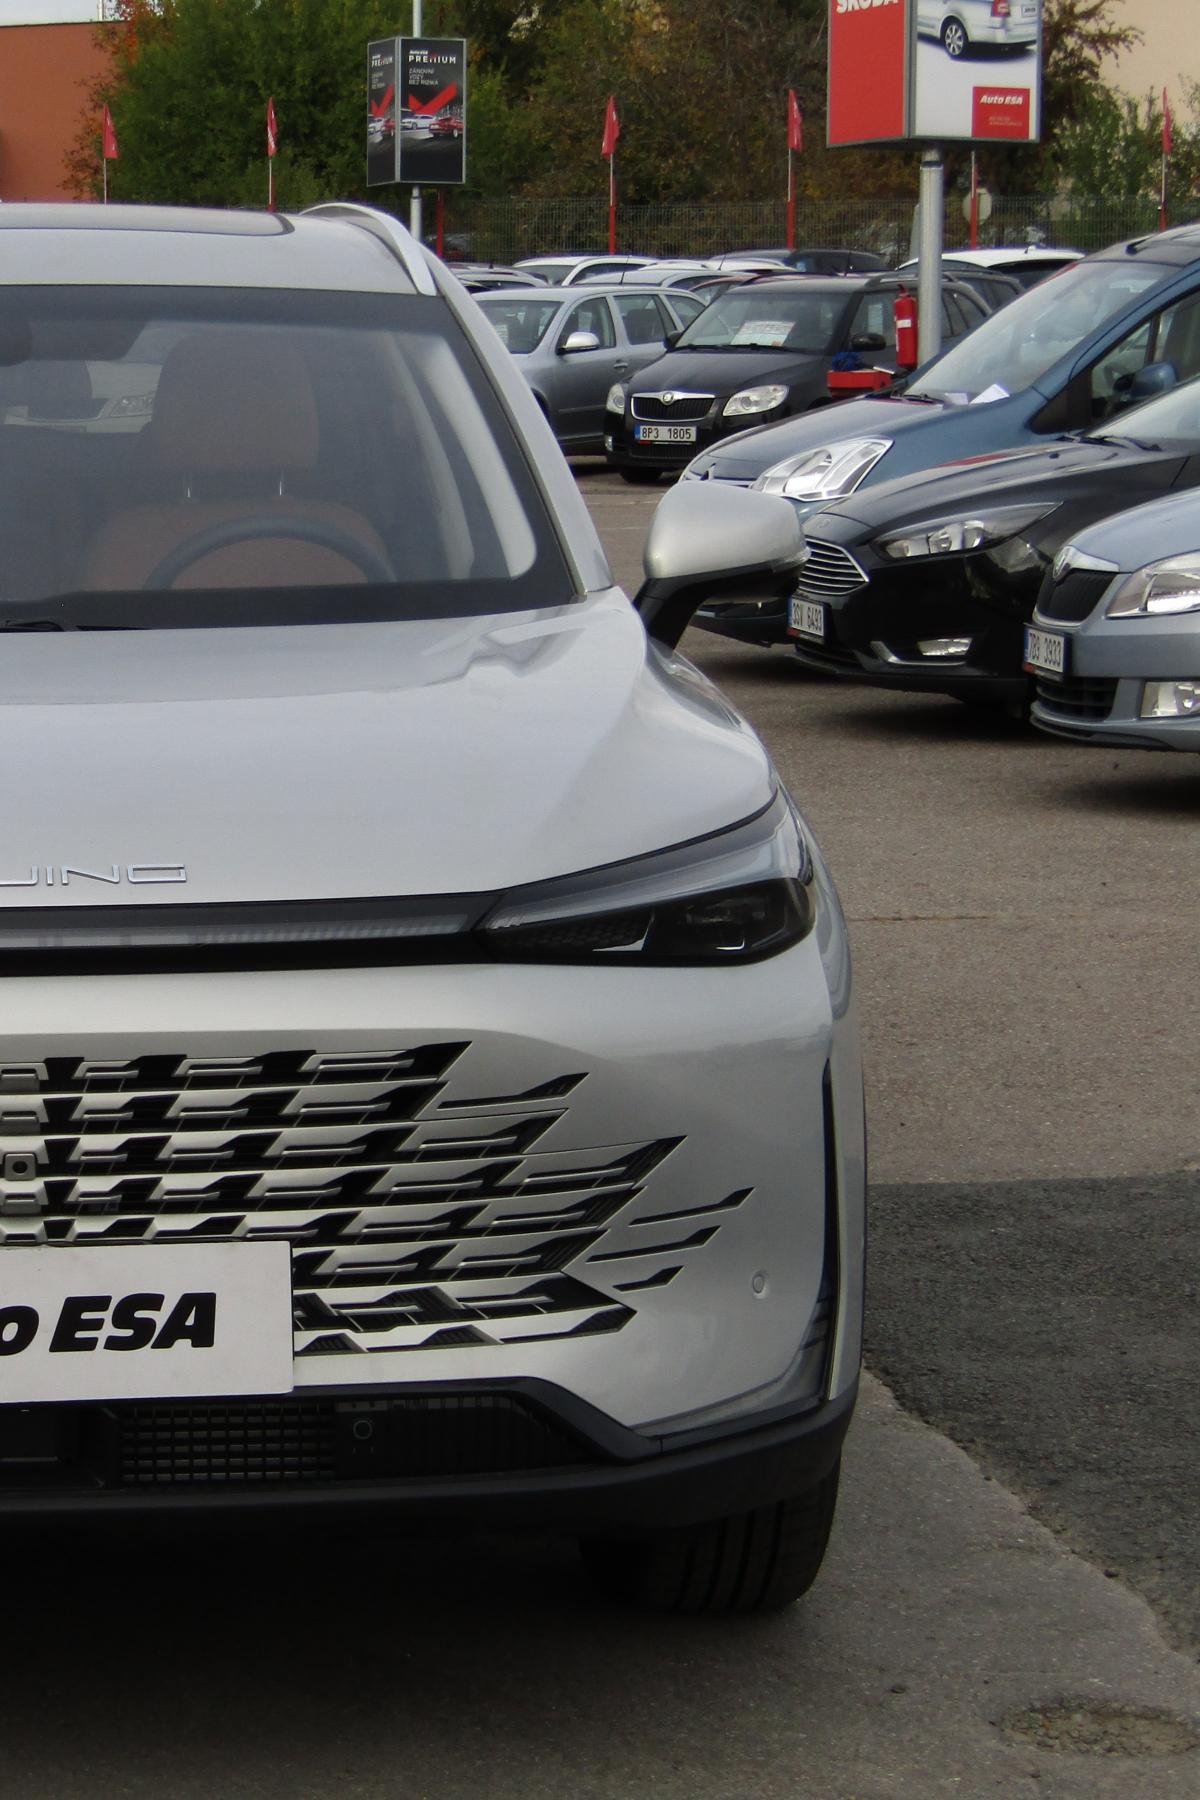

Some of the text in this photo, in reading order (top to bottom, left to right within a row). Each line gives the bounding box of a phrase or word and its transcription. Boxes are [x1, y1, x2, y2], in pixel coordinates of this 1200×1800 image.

[408, 55, 456, 64] PREMIUM
[979, 95, 1004, 104] Auto
[642, 427, 691, 439] 8P3 1805
[48, 1291, 217, 1353] ESA
